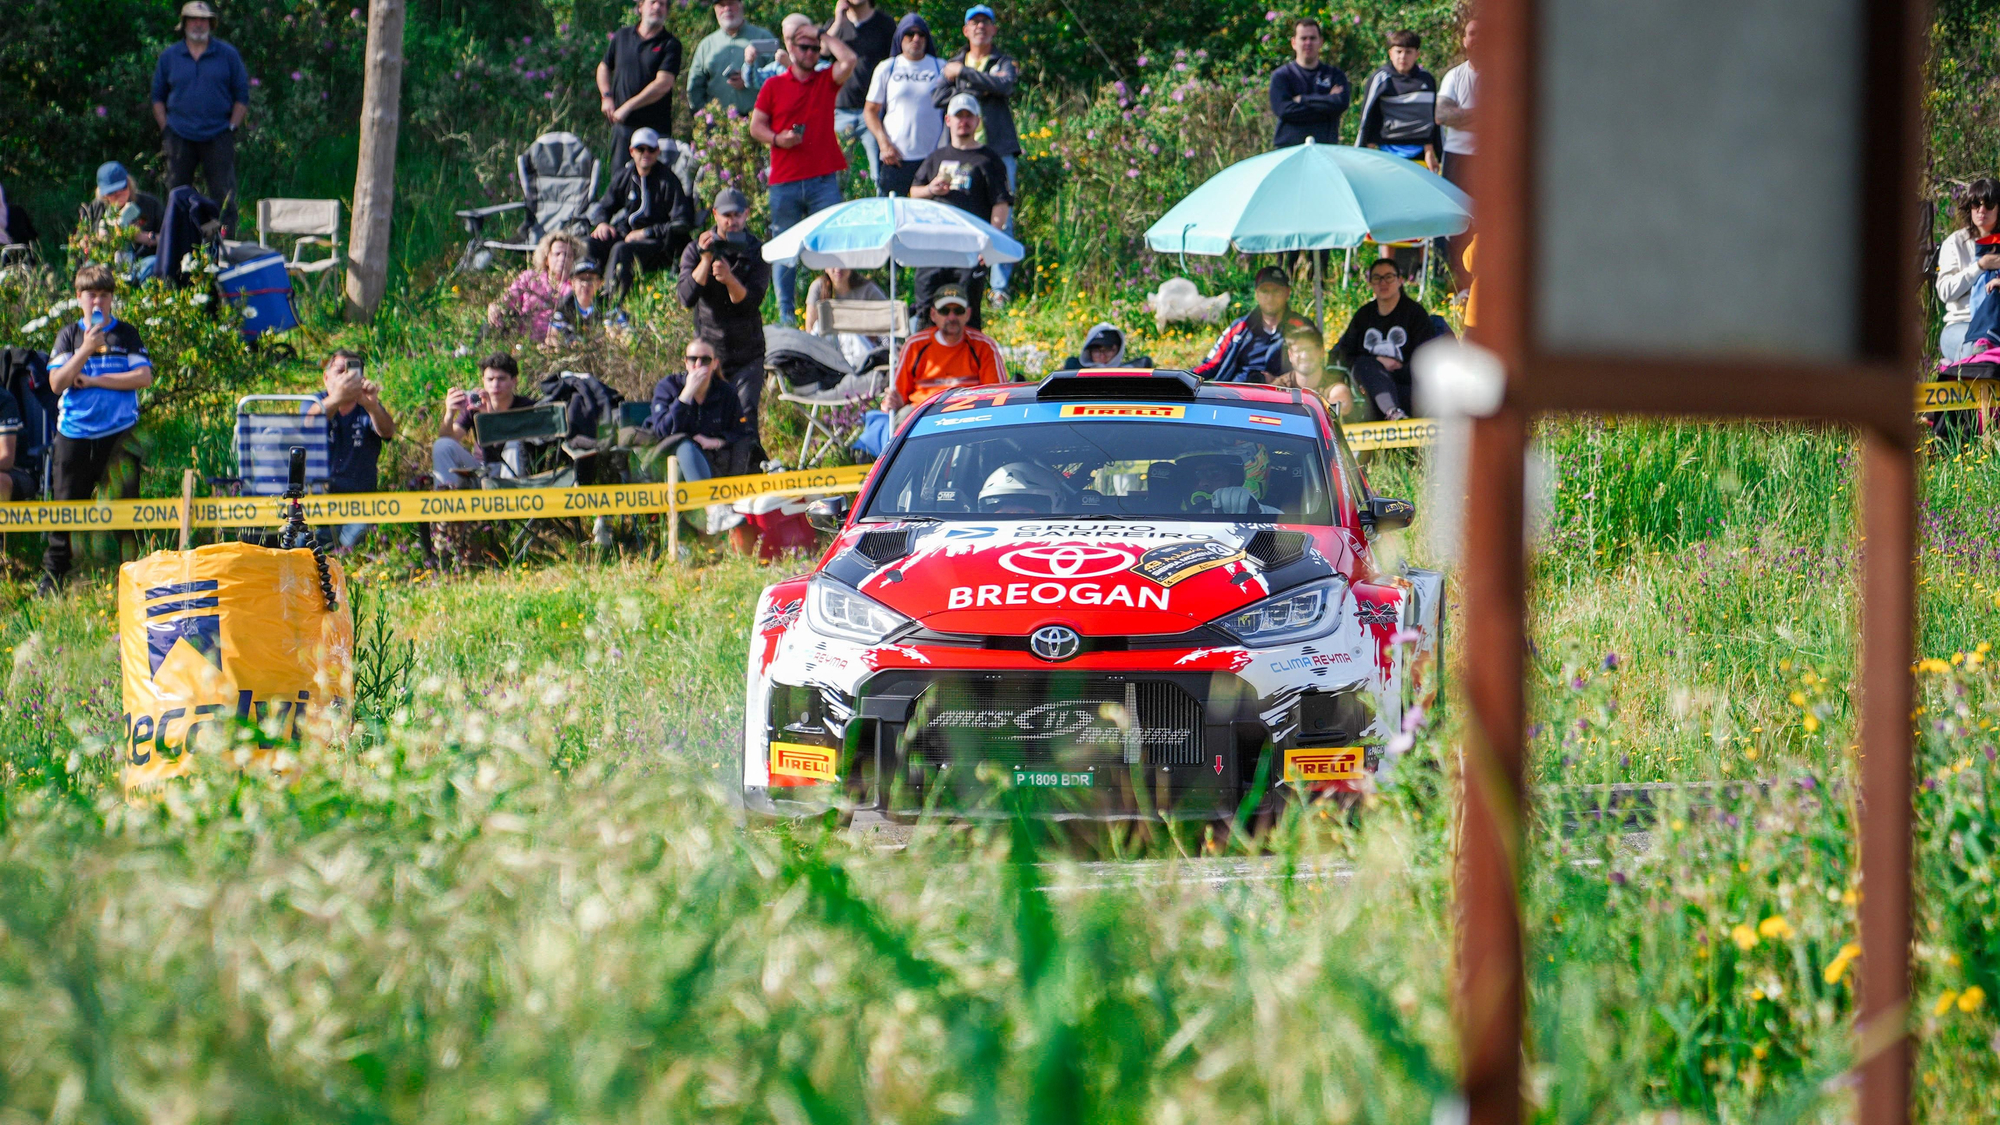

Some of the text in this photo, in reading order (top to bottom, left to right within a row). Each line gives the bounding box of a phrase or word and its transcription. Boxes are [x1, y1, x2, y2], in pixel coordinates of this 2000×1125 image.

[940, 392, 1010, 412] 21
[1925, 387, 1976, 405] ZONA
[1072, 405, 1173, 417] PIRELLI
[1362, 424, 1438, 443] PUBLICO
[709, 482, 757, 500] ZONA
[937, 491, 956, 499] OMP
[277, 500, 400, 519] ZNA PUBLICO
[420, 495, 544, 515] ZONA PUBLICO
[564, 492, 611, 509] ZONA
[0, 507, 112, 525] ONA PUBLICO
[133, 505, 179, 522] ZONA
[1013, 531, 1213, 540] BARREIRO
[947, 582, 1170, 610] BREOGAN
[1270, 653, 1353, 673] CLIMA REYMA
[778, 750, 829, 774] PIRELLI
[1016, 774, 1090, 786] P 1809 BDR
